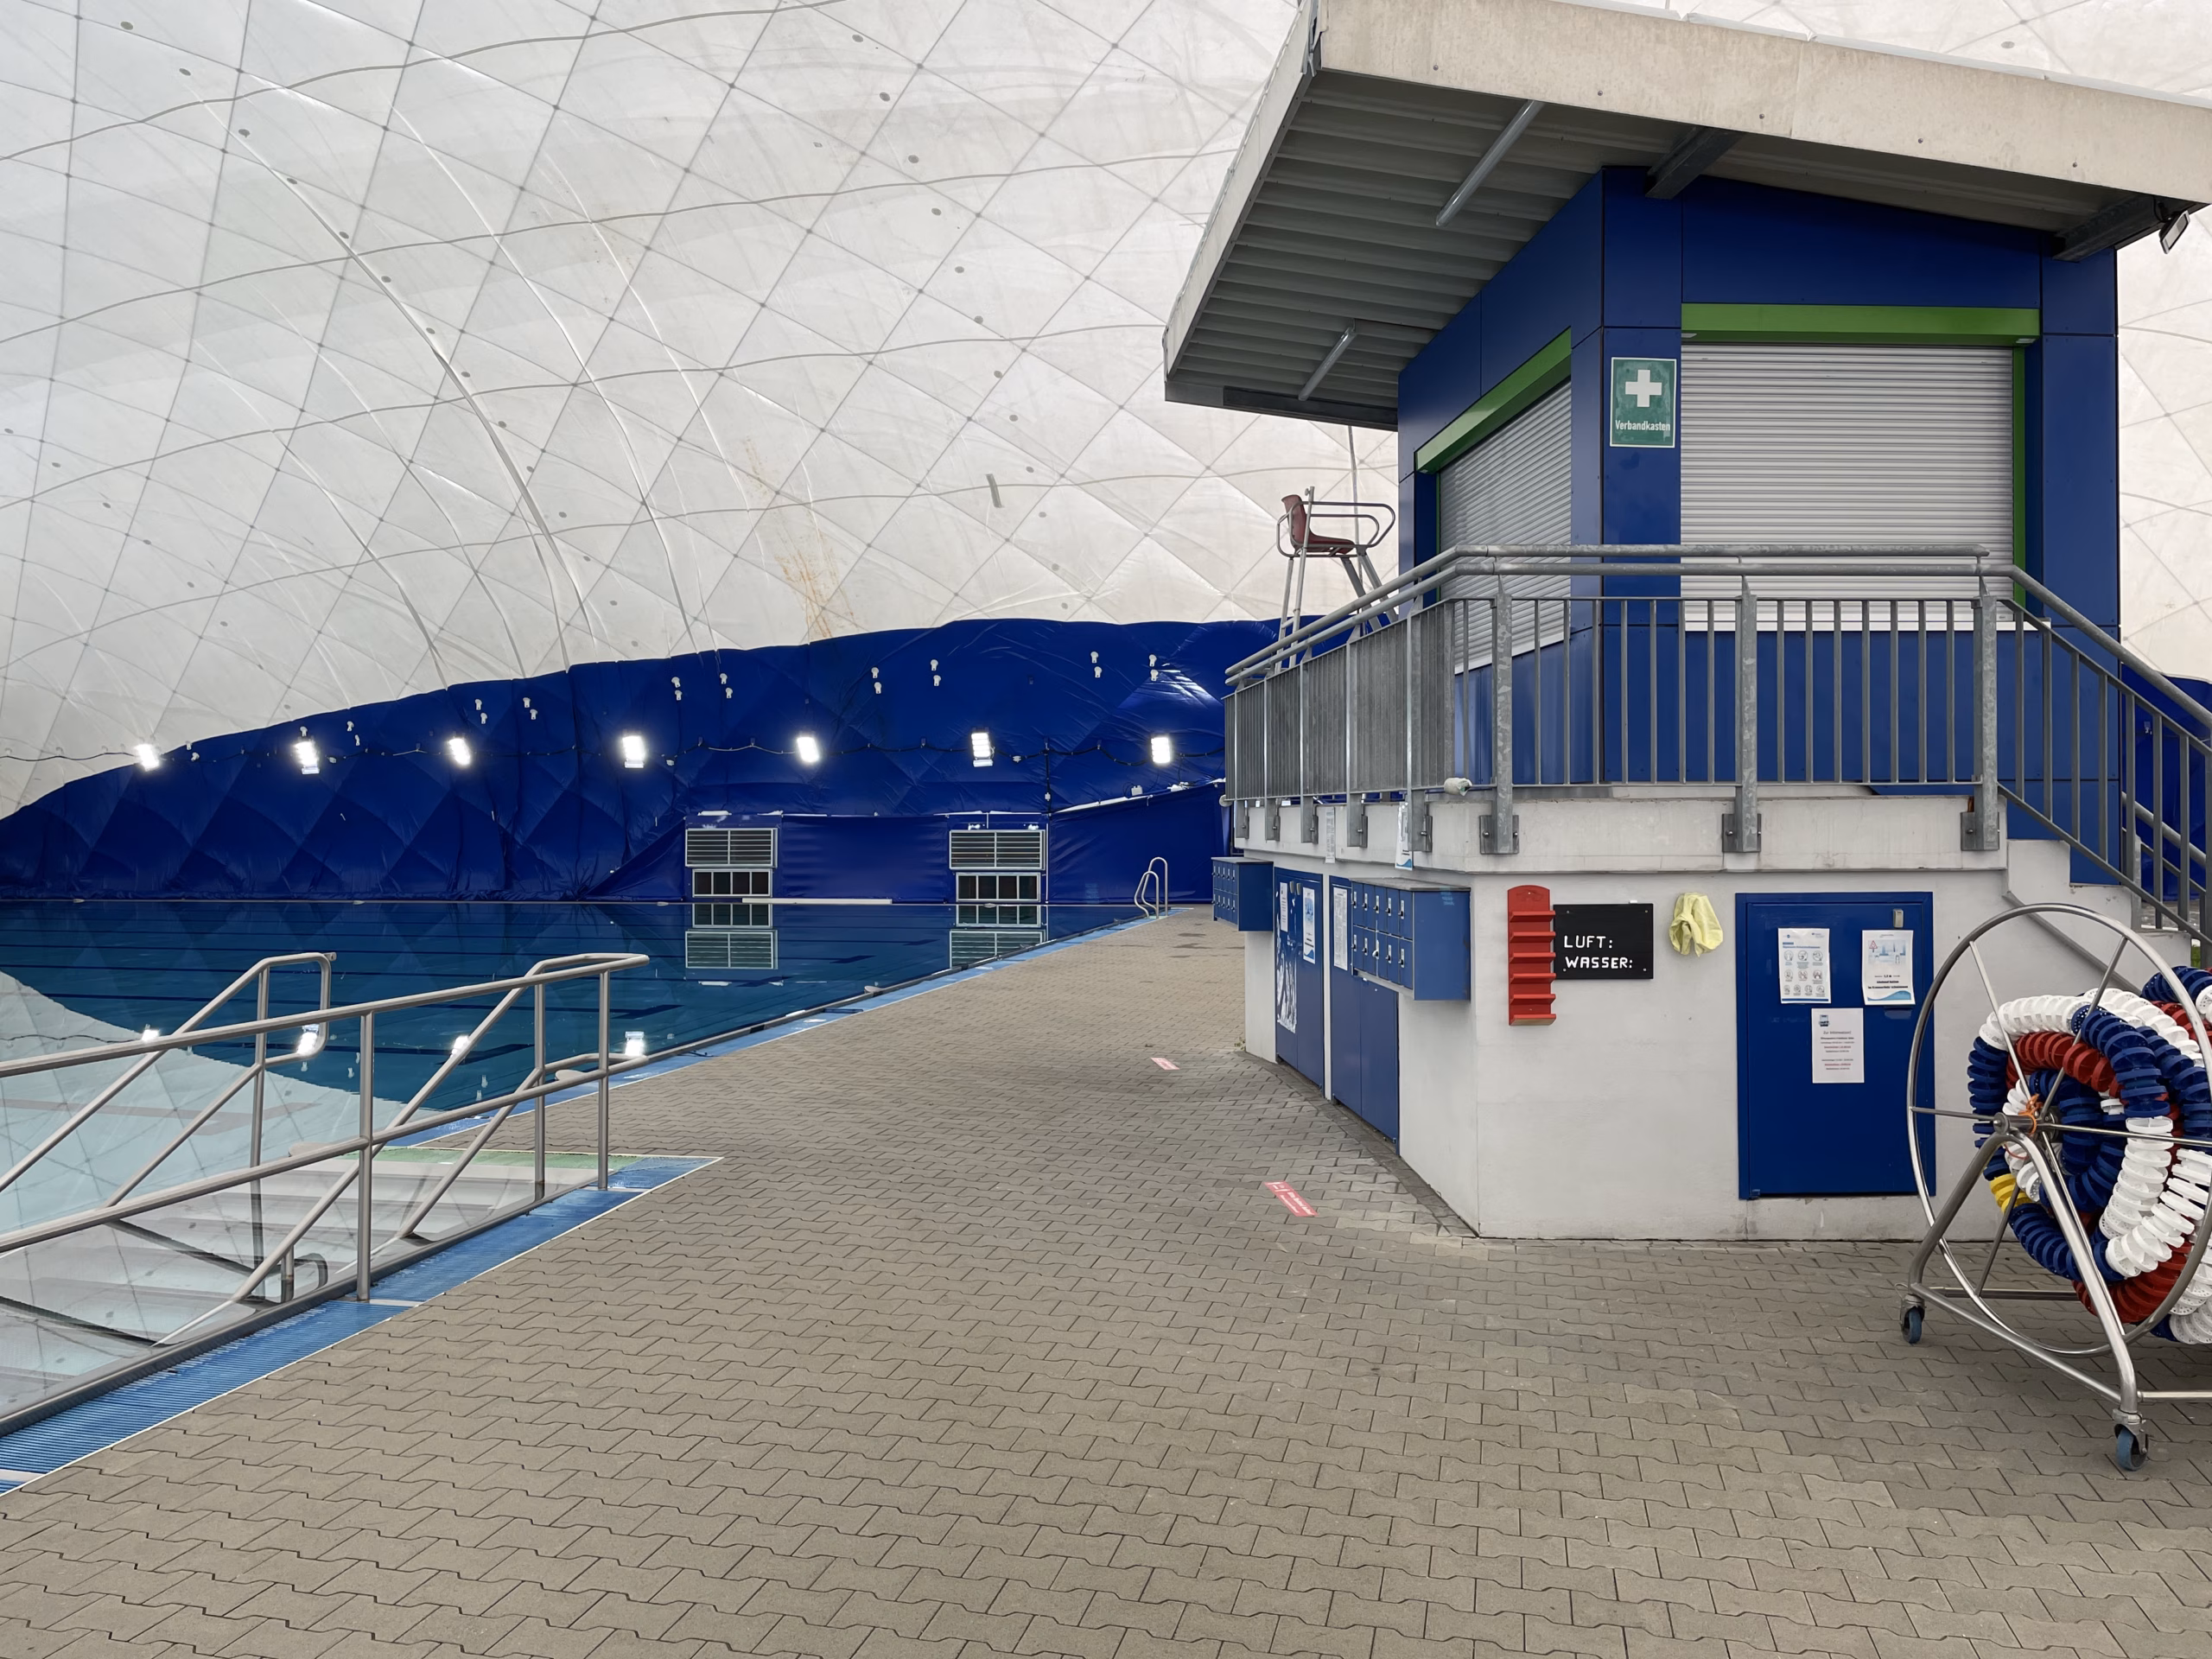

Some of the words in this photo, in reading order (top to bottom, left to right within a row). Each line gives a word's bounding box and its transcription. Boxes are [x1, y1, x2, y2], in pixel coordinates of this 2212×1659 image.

[1615, 420, 1671, 431] Verbandkasten
[1564, 935, 1613, 949] LUFT:
[1565, 956, 1633, 969] WASSER:
